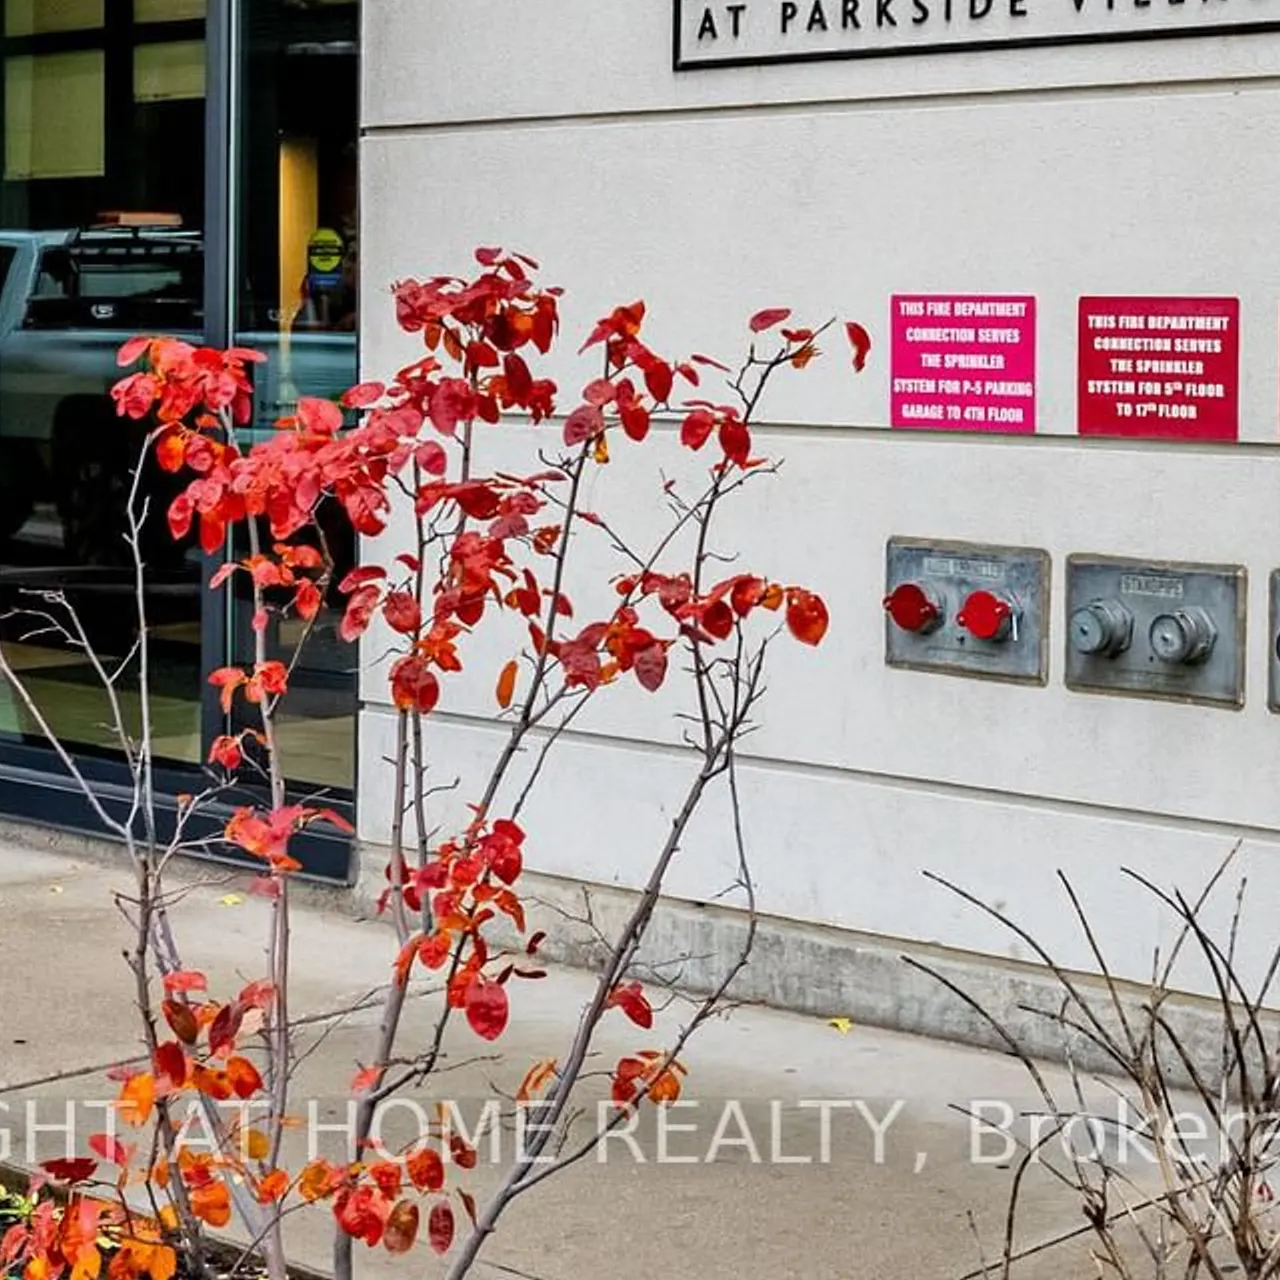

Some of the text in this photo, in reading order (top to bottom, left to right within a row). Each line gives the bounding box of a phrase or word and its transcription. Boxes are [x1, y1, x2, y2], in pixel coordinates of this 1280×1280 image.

[698, 4, 746, 40] AT
[899, 302, 1026, 317] THIS FIRE DEPARTMENT
[1088, 315, 1229, 331] THIS FIRE DEPARTMENT
[906, 327, 1020, 343] CONNECTION SERVES
[1094, 336, 1222, 353] CONNECTION SERVES
[921, 354, 1005, 369] THE SPRINKLER
[1110, 359, 1204, 375] THE SPRINKLER
[894, 378, 1033, 397] SYSTEM FOR P-5 PARKING
[1088, 380, 1135, 395] SYSTEM
[1138, 382, 1161, 396] FOR
[1185, 383, 1224, 398] FLOOR
[902, 404, 1023, 423] GARAGE TO 4TH FLOOR
[1116, 402, 1132, 416] TO
[1158, 404, 1197, 419] FLOOR
